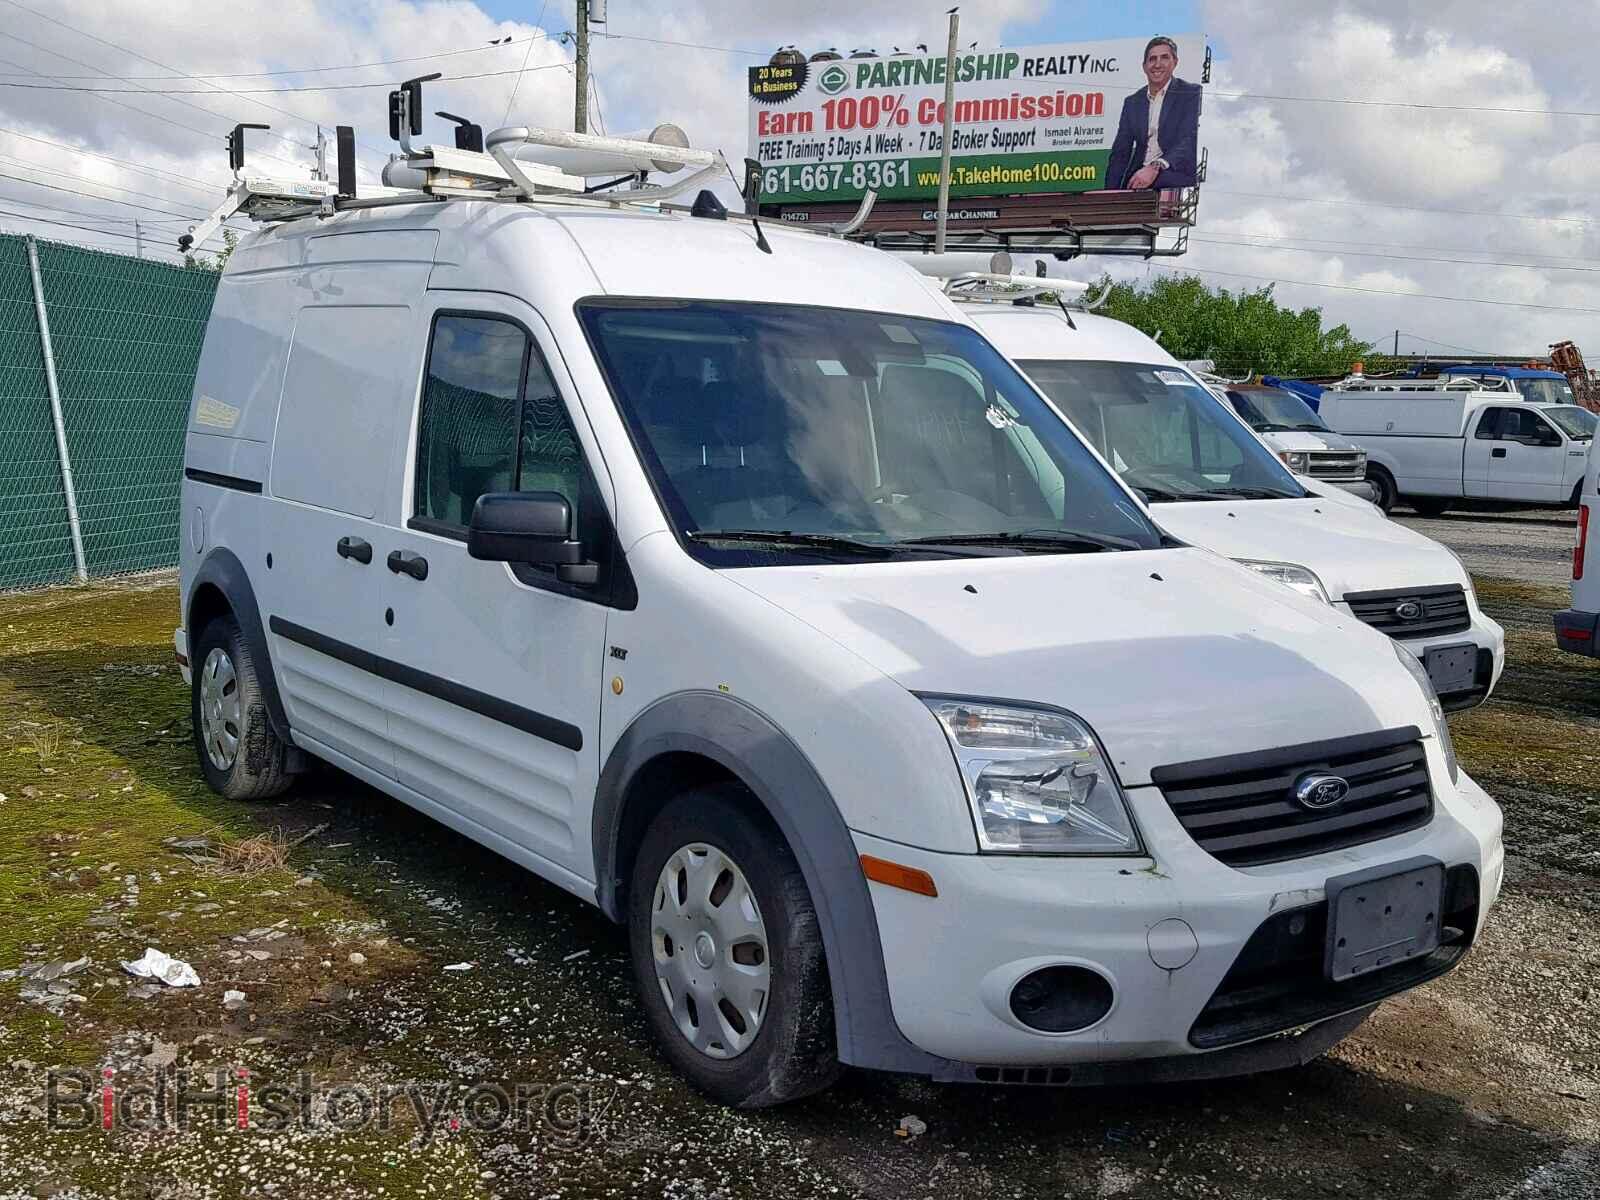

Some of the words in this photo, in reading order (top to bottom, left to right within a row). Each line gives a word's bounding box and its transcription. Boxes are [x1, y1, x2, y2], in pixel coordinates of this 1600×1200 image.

[759, 68, 769, 79] 20
[770, 67, 793, 78] Years
[1023, 54, 1090, 77] REALTY
[1090, 57, 1120, 73] INC.
[753, 82, 762, 93] in
[762, 81, 798, 92] Business
[758, 111, 813, 136] Earn
[821, 94, 909, 131] 100%
[917, 90, 1104, 125] Commission
[1044, 126, 1071, 137] Ismael
[1074, 125, 1104, 136] Alvarez
[758, 141, 784, 161] FREE
[786, 138, 826, 161] Training
[828, 137, 835, 156] 5
[837, 137, 861, 160] Days
[864, 135, 872, 154] A
[875, 132, 904, 154] Week
[919, 131, 927, 151] 7
[928, 131, 944, 151] Da
[952, 129, 989, 149] Broker
[991, 127, 1037, 152] Support
[760, 160, 910, 194] 61-667-8361
